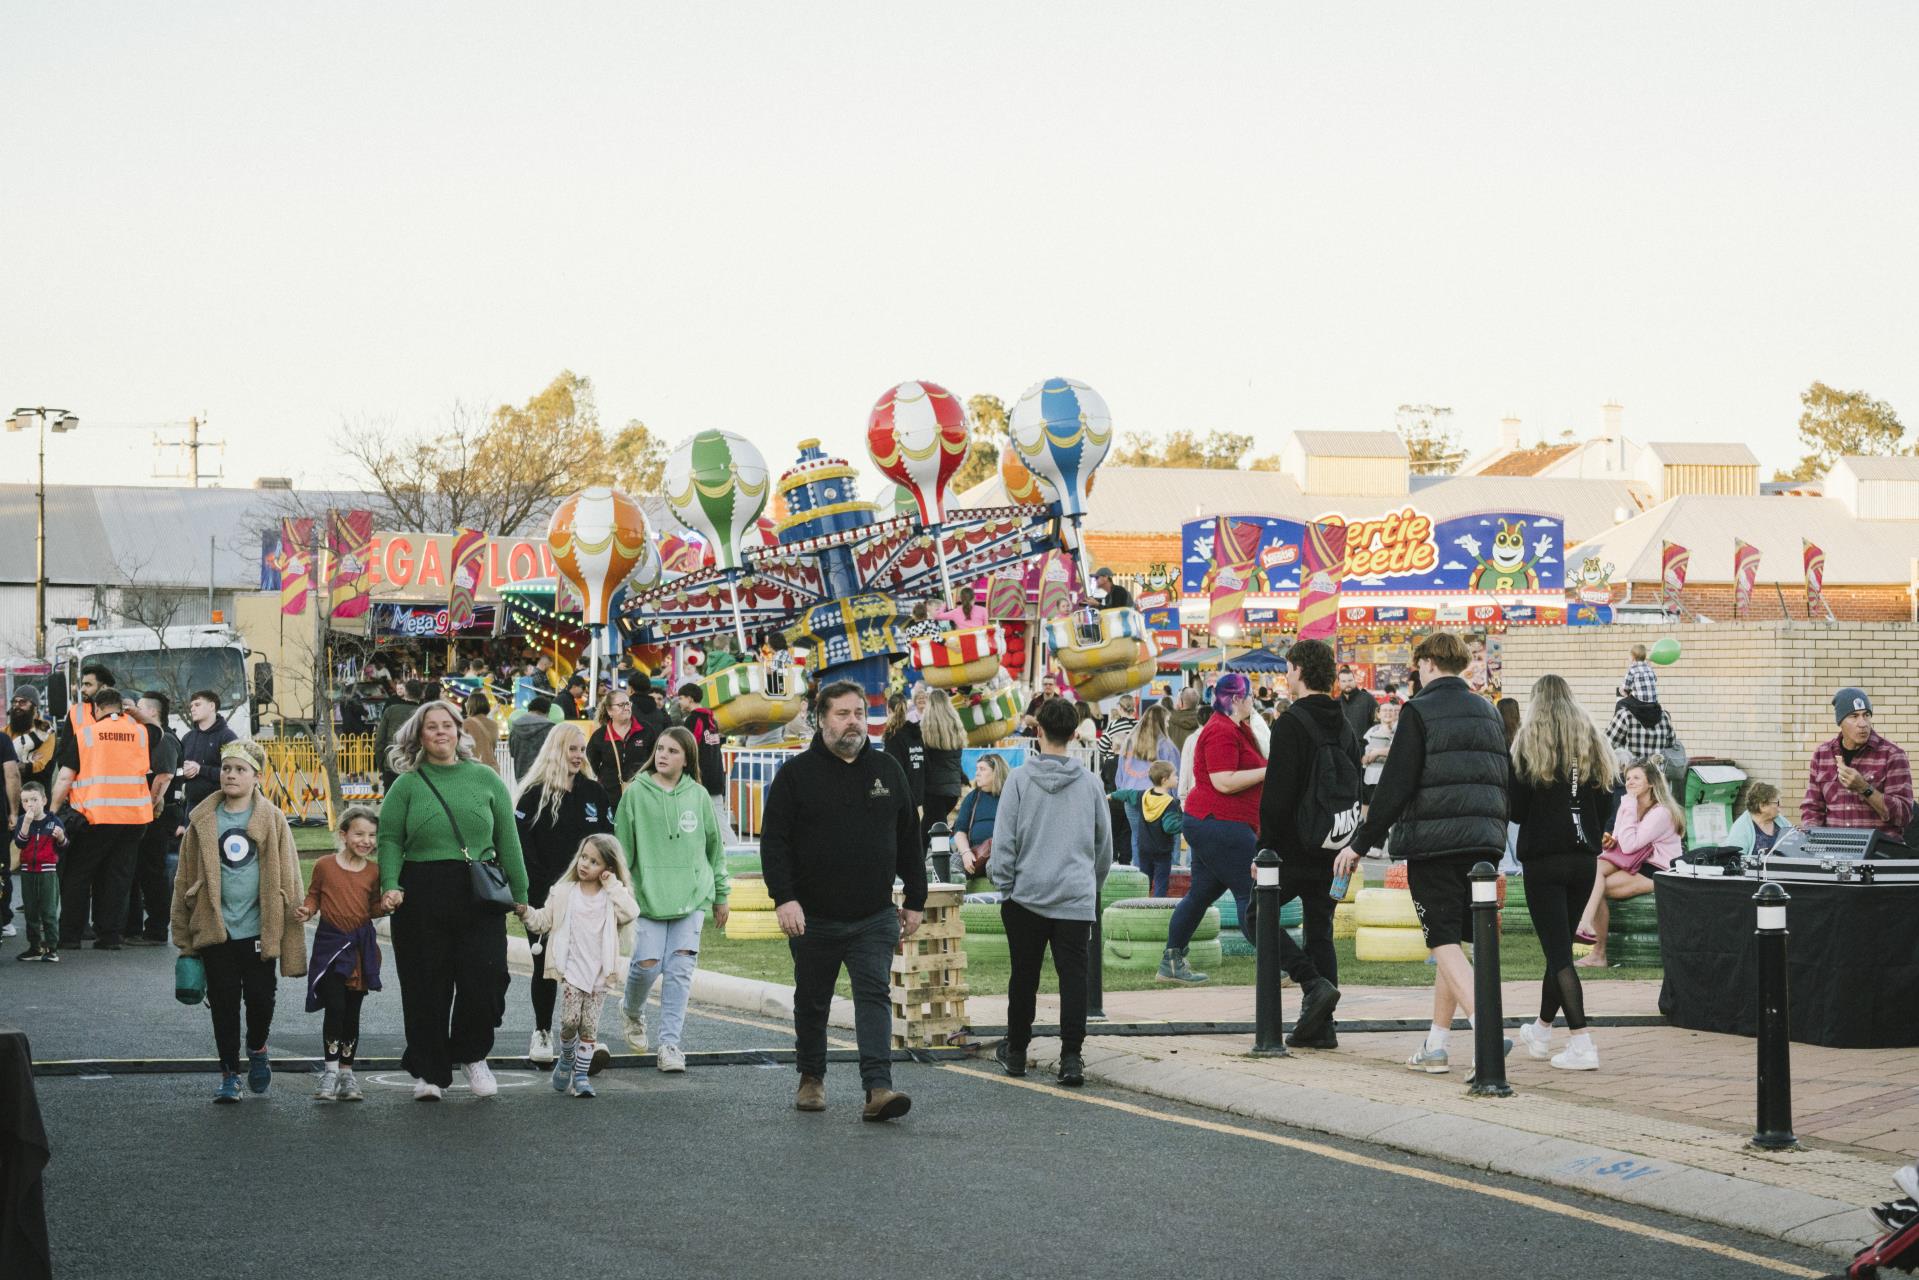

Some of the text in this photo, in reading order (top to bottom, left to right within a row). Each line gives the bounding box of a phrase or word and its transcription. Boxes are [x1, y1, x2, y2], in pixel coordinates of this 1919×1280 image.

[391, 605, 434, 635] Mega
[98, 732, 136, 742] SECURITY
[1332, 800, 1360, 838] NIKE
